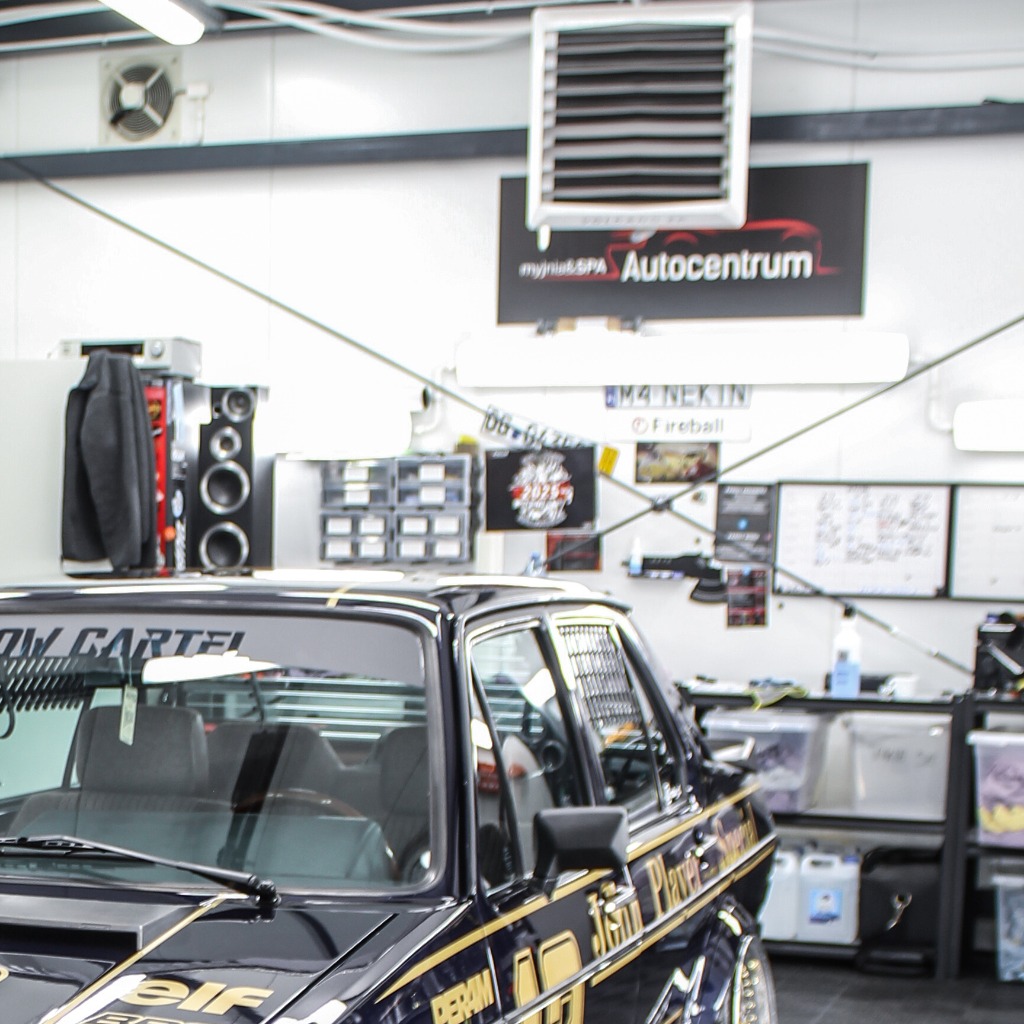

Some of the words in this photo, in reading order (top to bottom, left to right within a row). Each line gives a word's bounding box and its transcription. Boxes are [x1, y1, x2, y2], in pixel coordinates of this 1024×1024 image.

[621, 249, 813, 282] Autocentrum
[652, 418, 724, 433] Fireball
[119, 978, 275, 1016] elf
